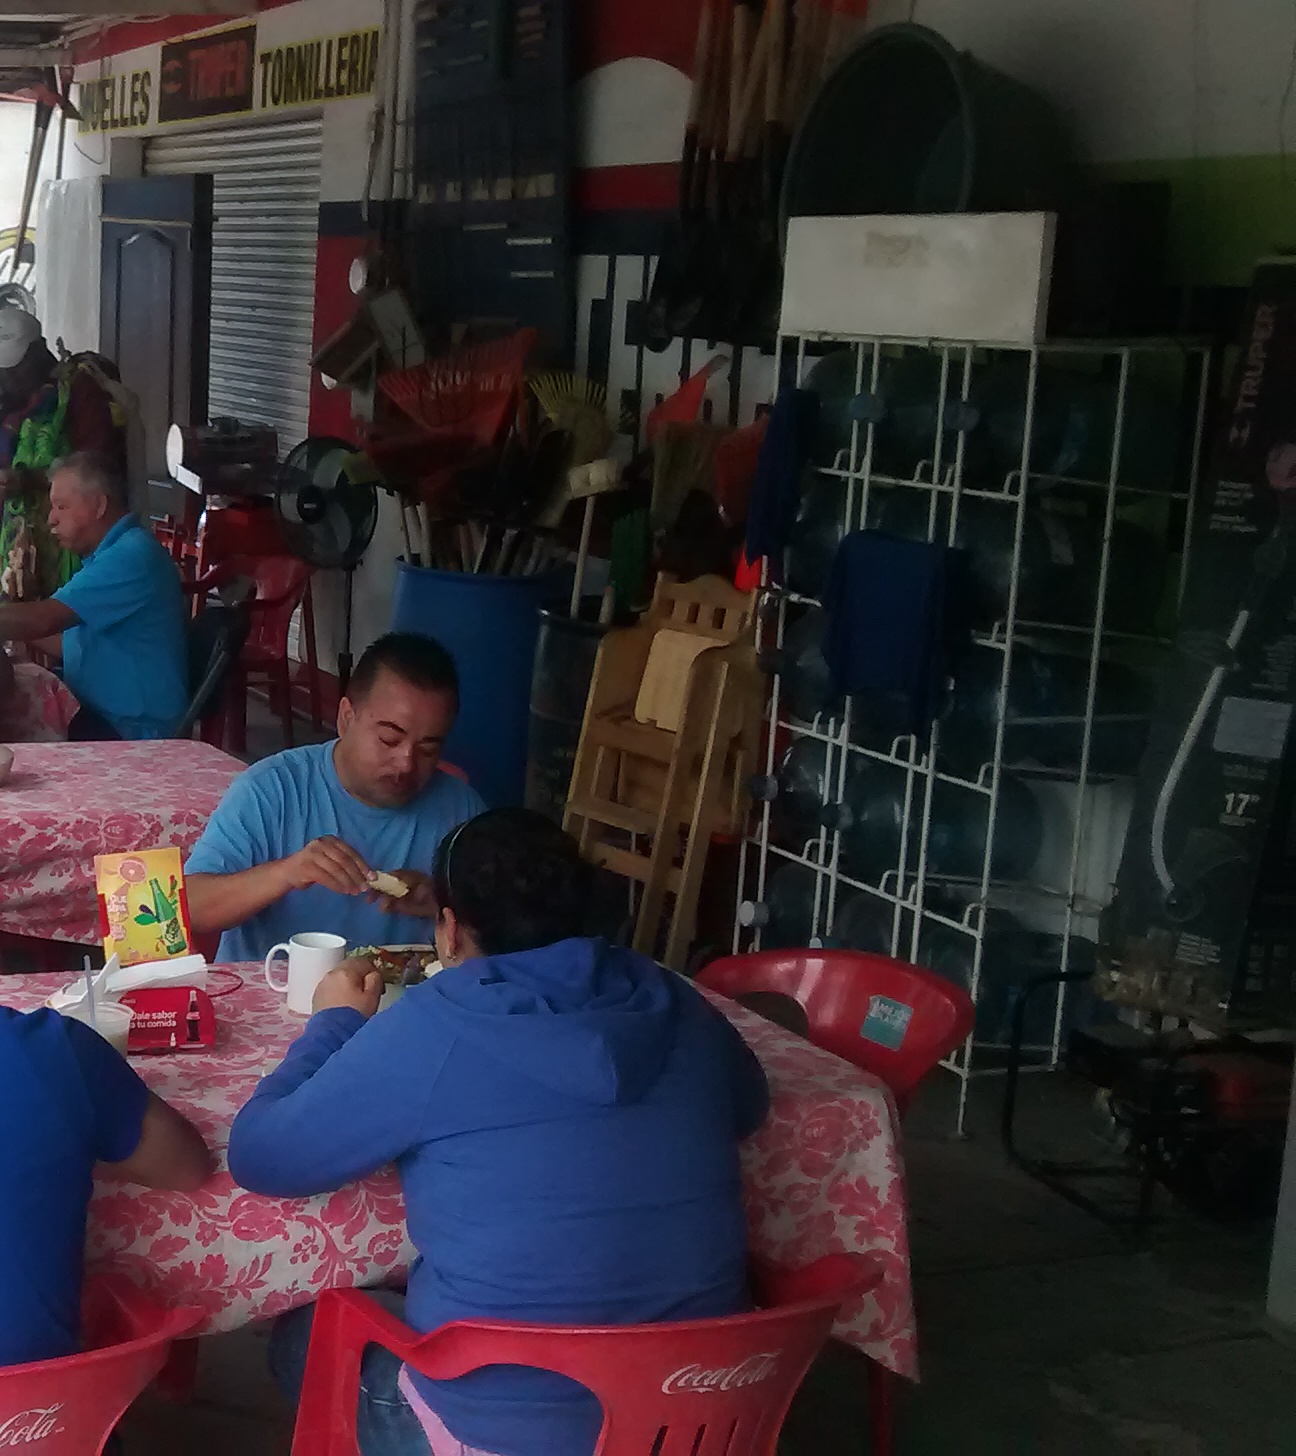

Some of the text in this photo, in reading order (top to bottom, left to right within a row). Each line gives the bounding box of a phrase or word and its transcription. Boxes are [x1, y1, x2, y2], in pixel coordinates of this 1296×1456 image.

[1234, 303, 1278, 414] TRUPER
[137, 1020, 146, 1028] tu
[147, 1019, 177, 1028] comida
[151, 1010, 177, 1020] sabor
[661, 1348, 783, 1395] Coca-Cola
